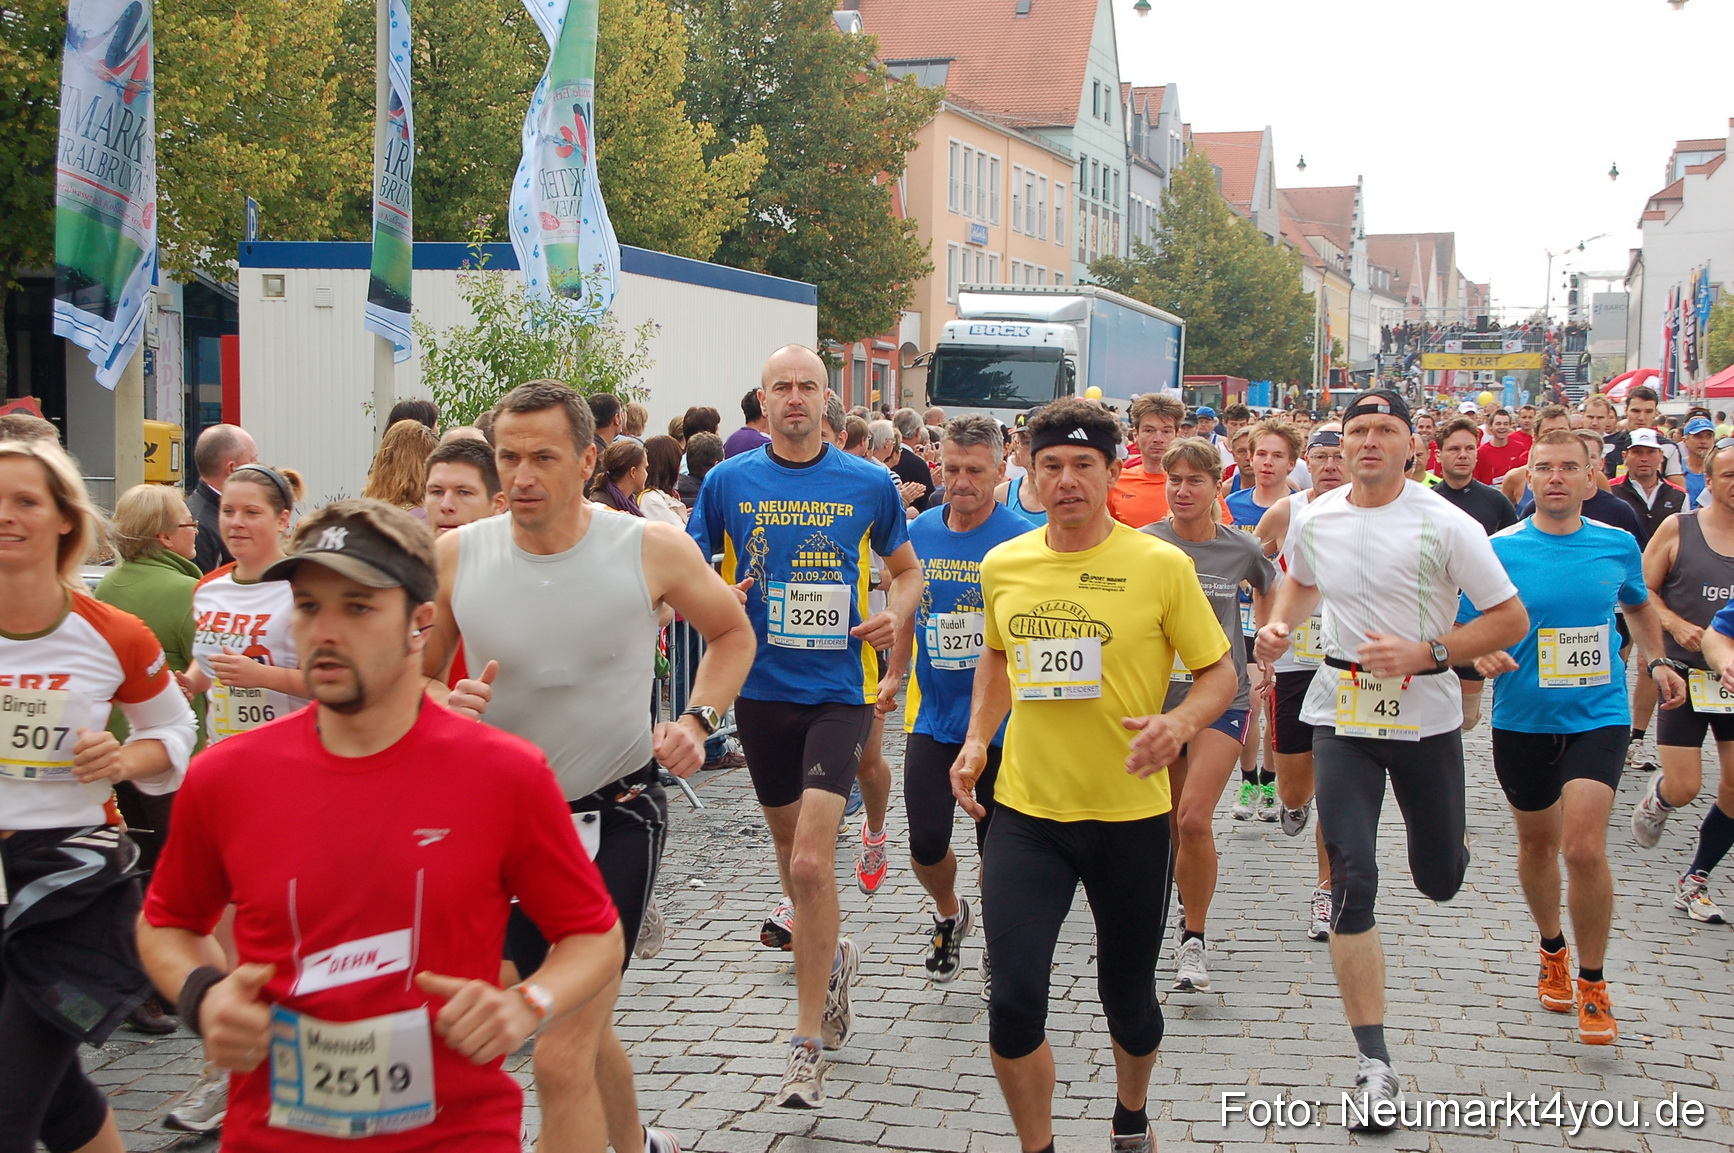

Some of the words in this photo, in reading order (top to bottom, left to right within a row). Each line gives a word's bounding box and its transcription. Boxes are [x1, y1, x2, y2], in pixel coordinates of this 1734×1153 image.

[969, 325, 1031, 337] BOCK
[1460, 356, 1501, 366] START
[739, 502, 756, 514] 10.
[758, 501, 854, 517] NEUMARKTER
[755, 513, 835, 527] STADTLAUF
[928, 559, 981, 573] NEUMARK
[924, 568, 981, 584] STADTLAU
[790, 589, 823, 602] Martin
[1702, 581, 1734, 602] igel
[790, 608, 840, 627] 3269
[941, 618, 966, 630] Rudolf
[1310, 620, 1321, 631] Ha
[1019, 617, 1098, 638] FRANCESCO
[942, 632, 984, 650] 3270
[1559, 632, 1599, 645] Gerhard
[1040, 650, 1084, 673] 260
[1541, 650, 1547, 660] B
[1567, 649, 1601, 667] 469
[1360, 678, 1382, 692] Uwe
[3, 694, 47, 717] Birgit
[238, 704, 275, 723] 506
[1374, 700, 1400, 717] 43
[12, 724, 70, 751] 507
[327, 947, 380, 976] DEHN
[312, 1061, 413, 1098] 2519
